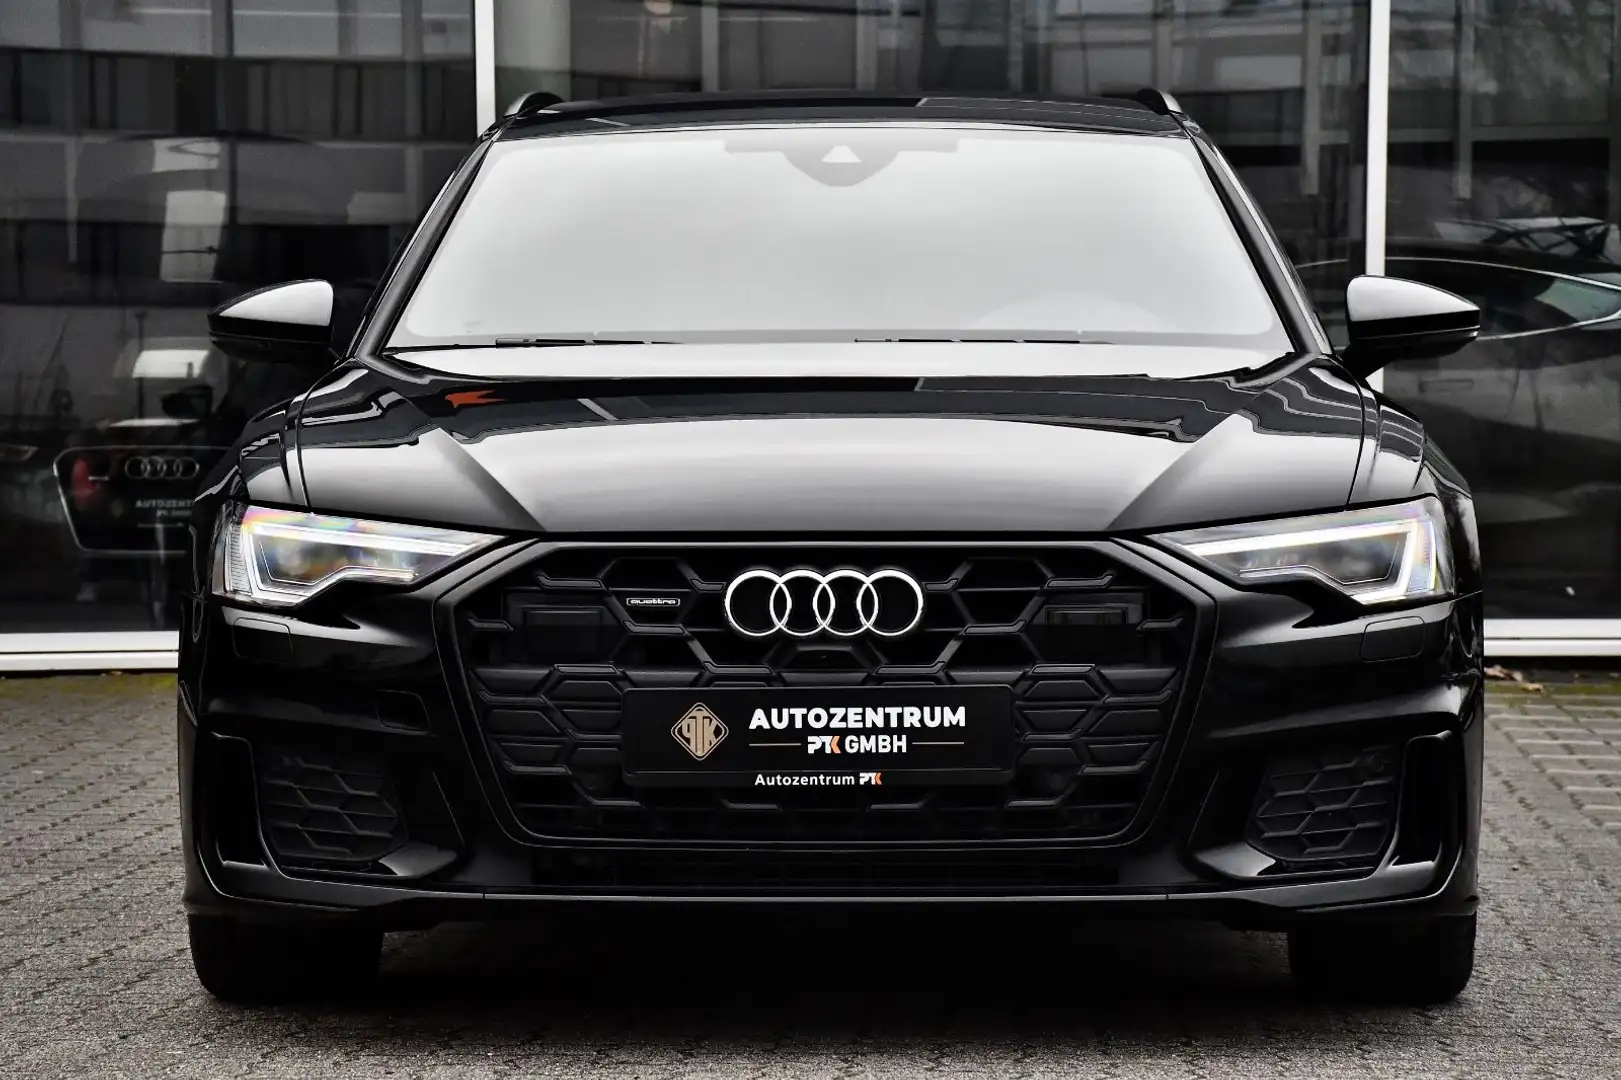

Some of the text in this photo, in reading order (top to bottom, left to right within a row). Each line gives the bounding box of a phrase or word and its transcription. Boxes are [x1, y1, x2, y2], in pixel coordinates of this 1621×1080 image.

[135, 499, 193, 508] AUTOZENT
[749, 706, 966, 729] AUTOZENTRUM
[807, 734, 907, 754] PTK GMBH
[754, 772, 883, 786] Autozentrum PTK
